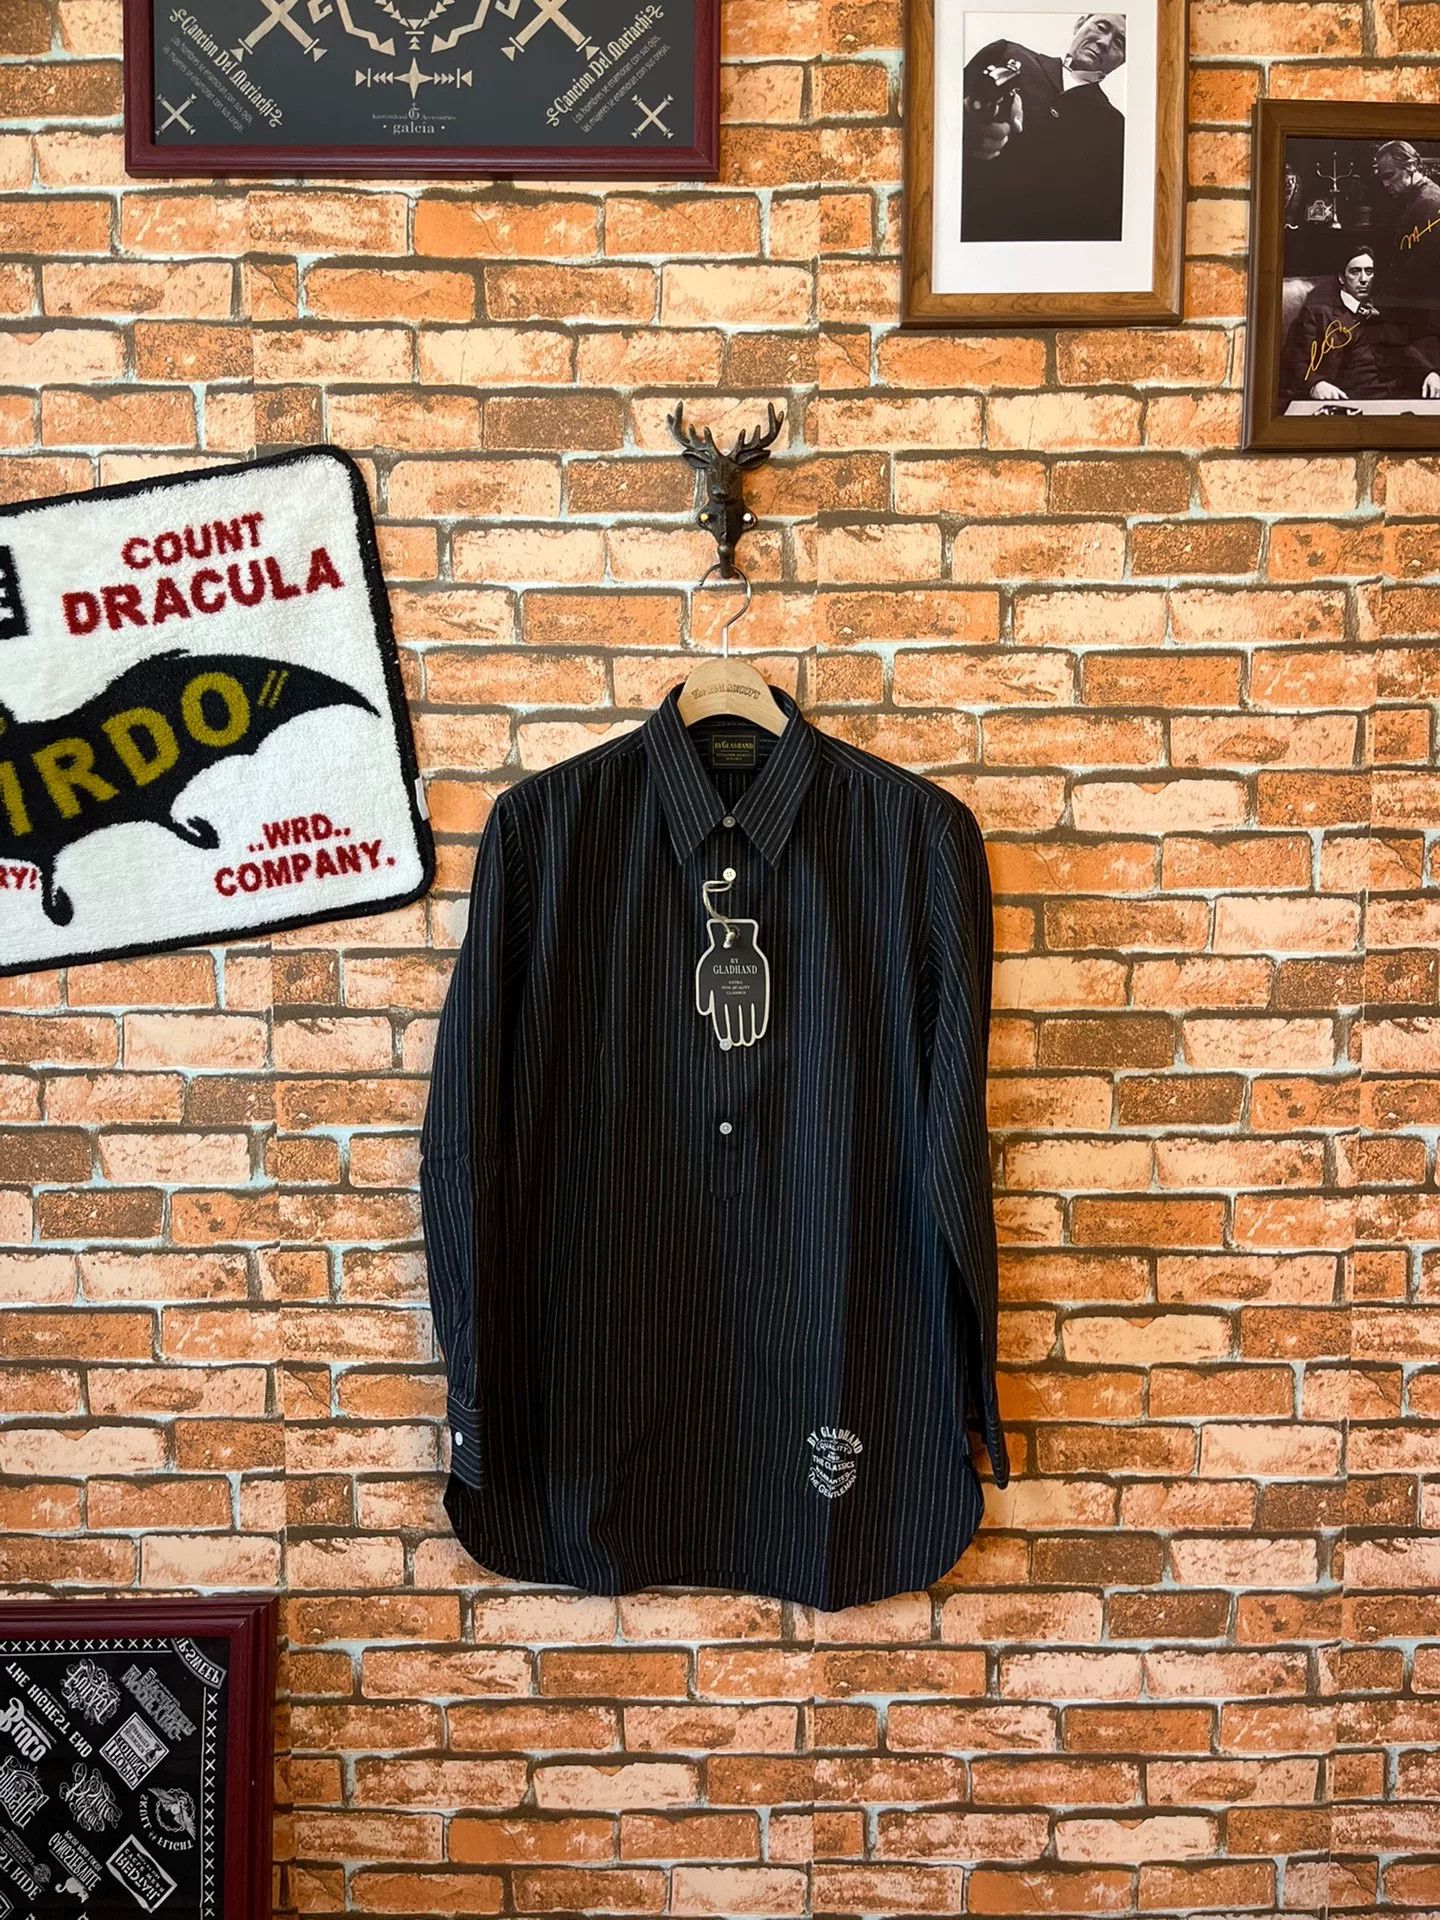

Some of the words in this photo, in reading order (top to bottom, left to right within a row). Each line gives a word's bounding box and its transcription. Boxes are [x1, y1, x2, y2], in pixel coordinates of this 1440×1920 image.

[588, 50, 613, 78] Del
[607, 10, 653, 61] Mariachi
[213, 50, 238, 75] Del
[229, 70, 277, 116] Mariachi
[122, 512, 264, 570] COUNT
[63, 547, 345, 635] DRACULA
[215, 838, 396, 897] COMPANY.
[713, 964, 758, 975] GLADHAND
